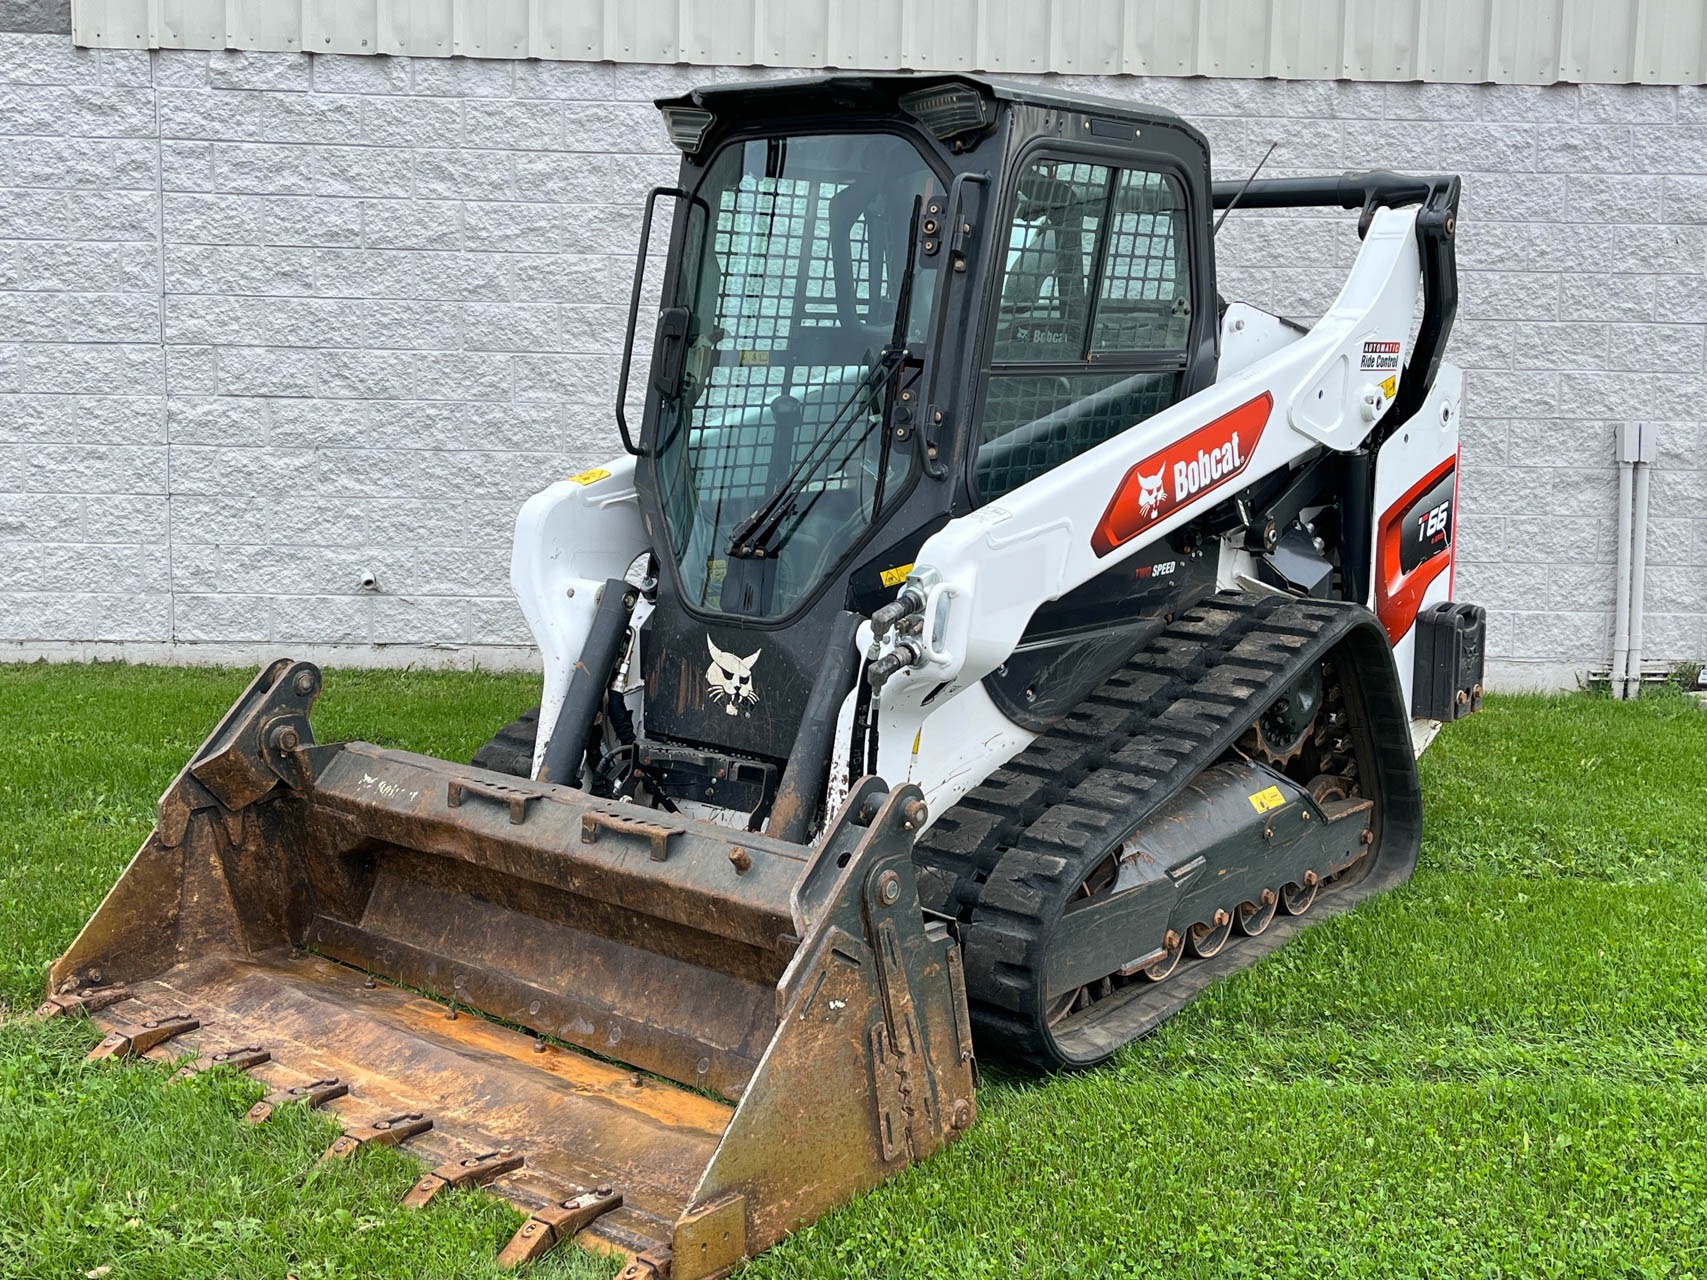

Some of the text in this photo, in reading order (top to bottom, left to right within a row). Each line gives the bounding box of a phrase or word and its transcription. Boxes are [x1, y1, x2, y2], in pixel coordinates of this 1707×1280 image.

[1364, 343, 1399, 353] AUTOMATIC
[1360, 354, 1399, 368] Ride Control
[1174, 431, 1241, 503] Bobcat
[1418, 501, 1449, 542] T66
[1152, 561, 1176, 578] SPEED
